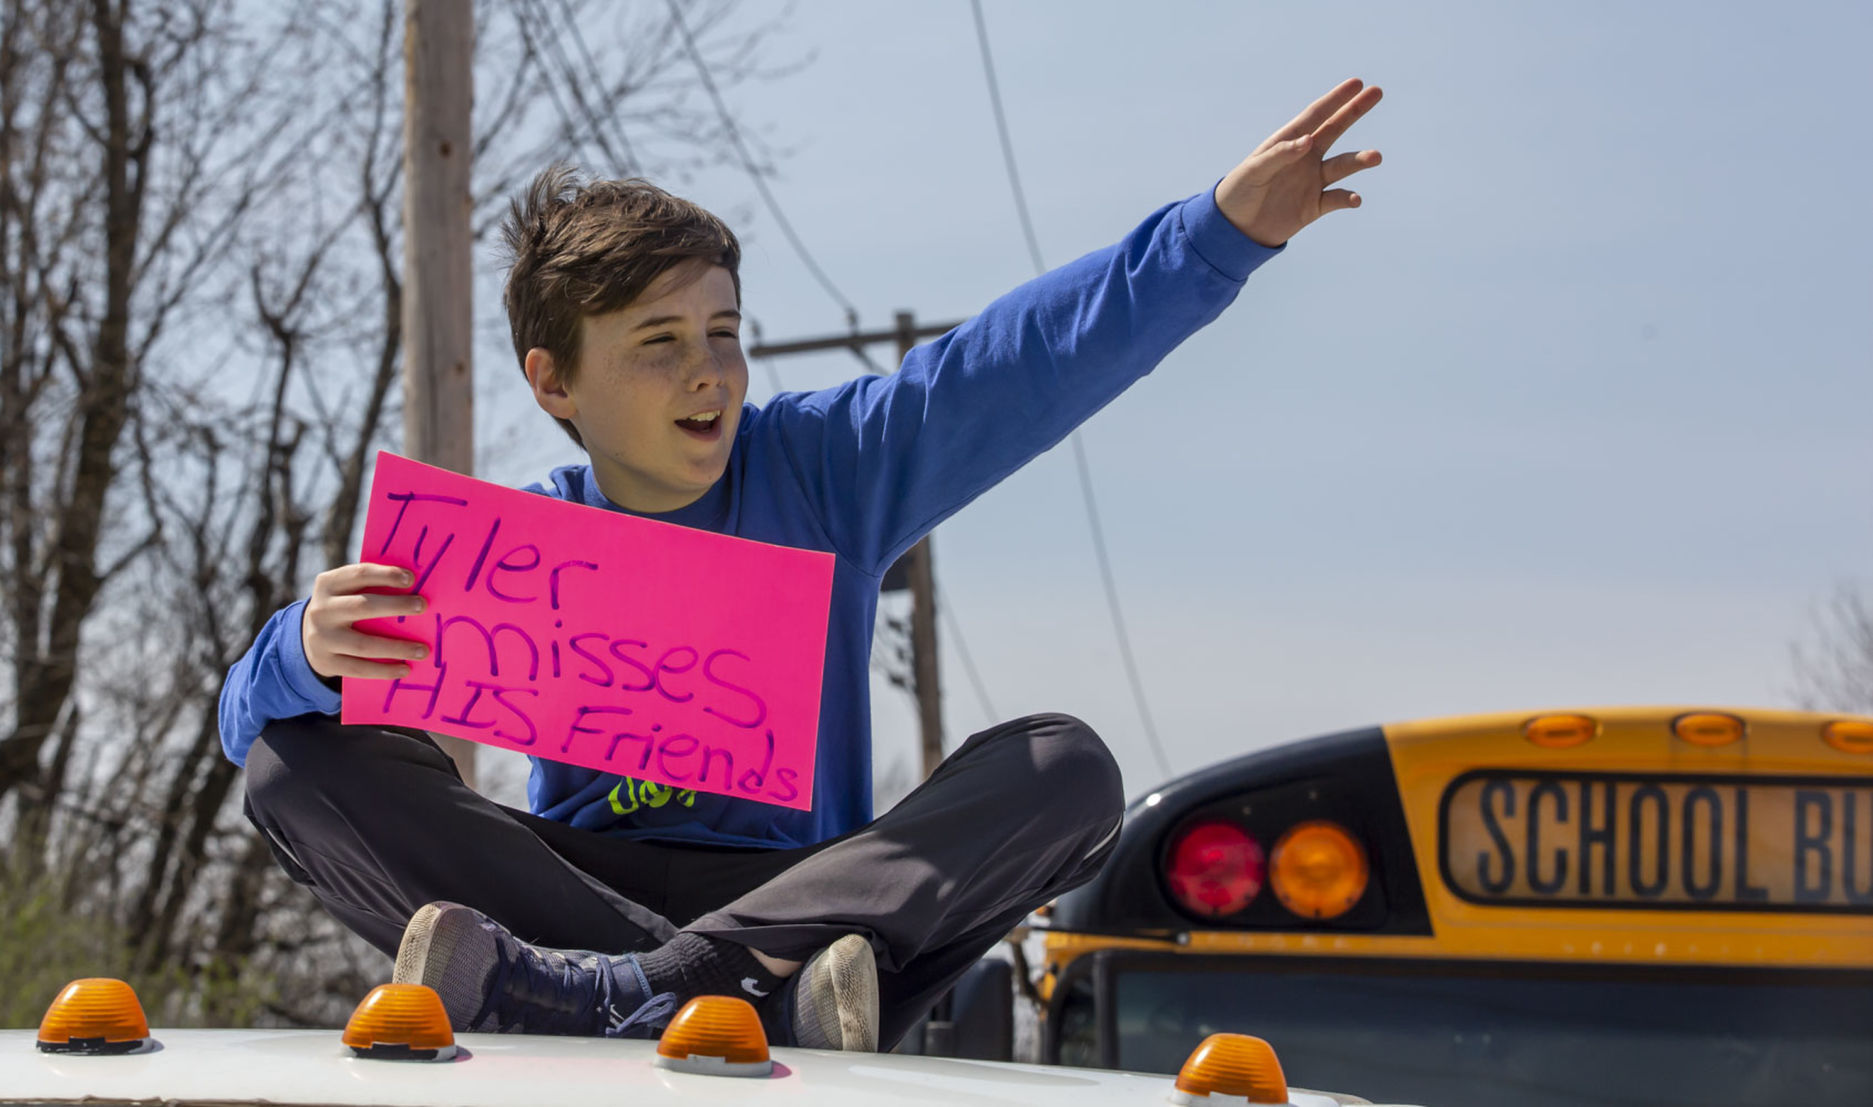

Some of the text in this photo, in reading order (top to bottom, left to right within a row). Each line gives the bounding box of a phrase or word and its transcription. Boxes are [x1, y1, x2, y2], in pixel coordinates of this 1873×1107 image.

[381, 491, 599, 623] Tyler
[382, 661, 539, 747] HIS
[560, 705, 799, 802] Friends
[1477, 779, 1769, 903] SCHOOL
